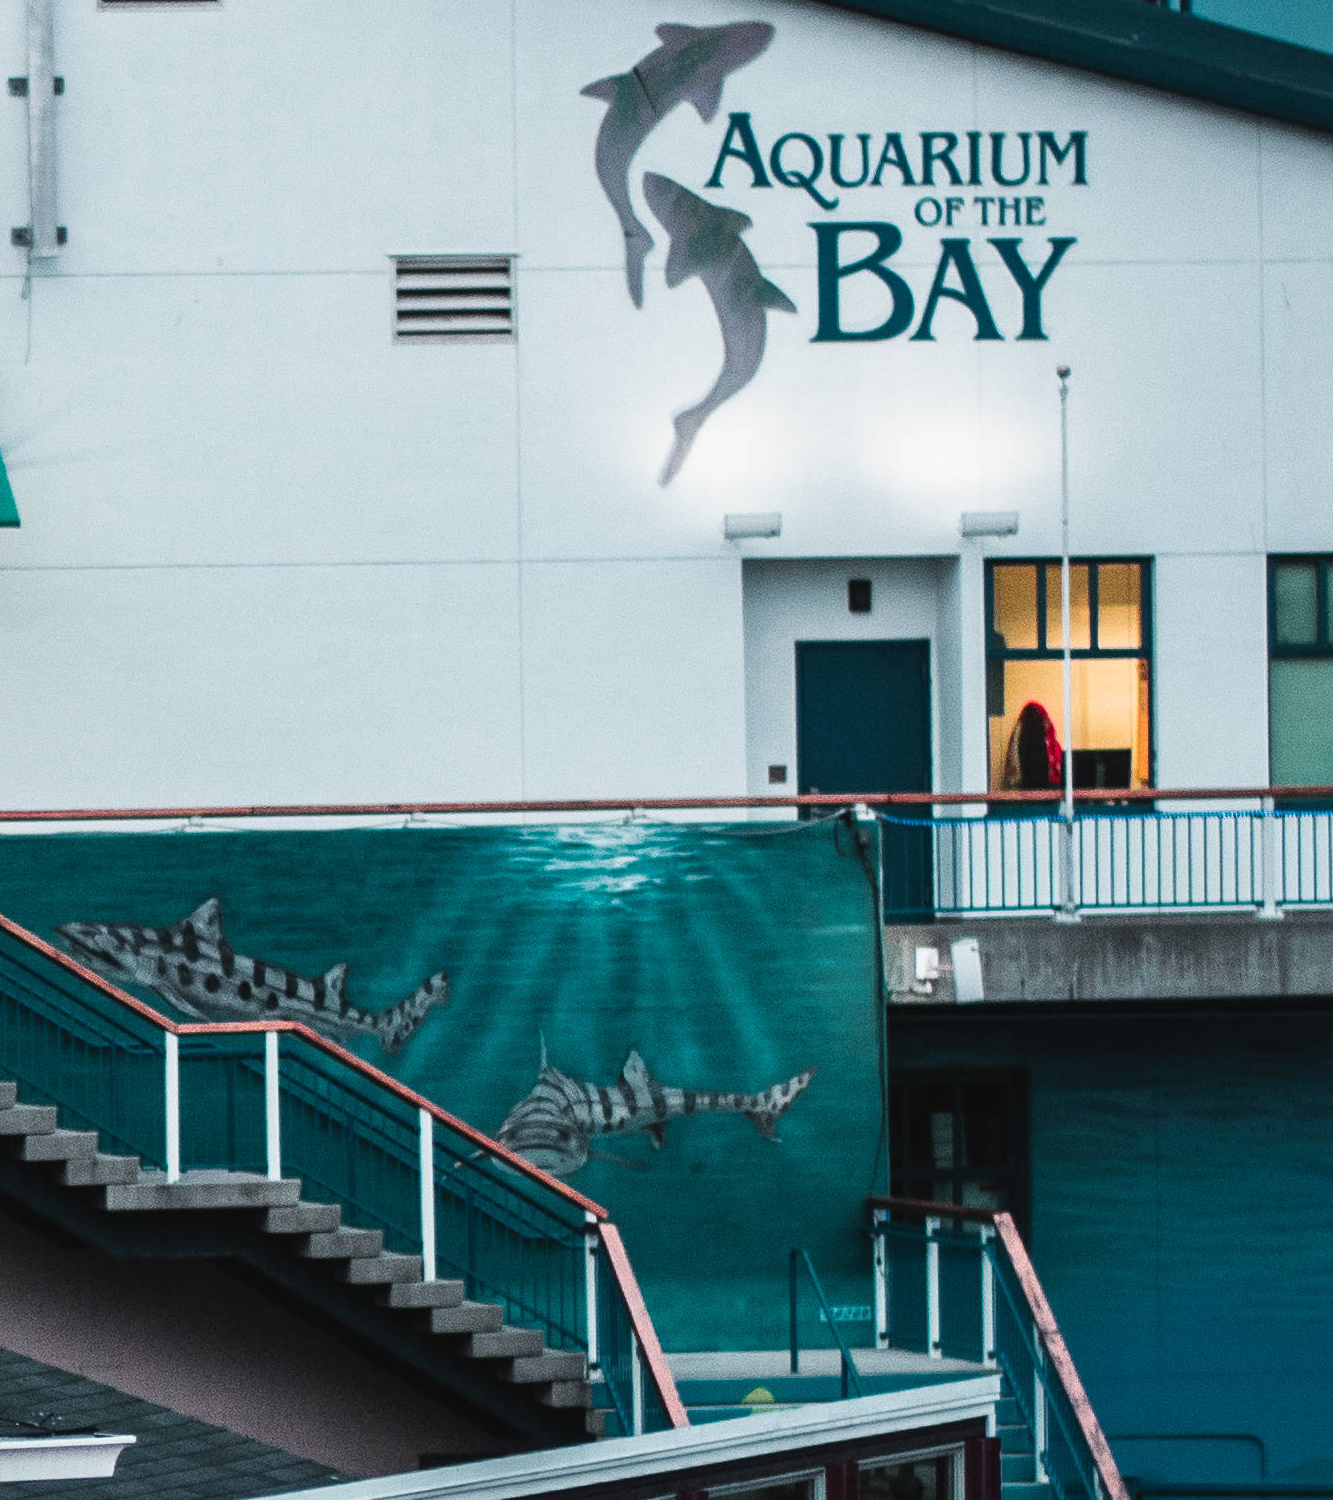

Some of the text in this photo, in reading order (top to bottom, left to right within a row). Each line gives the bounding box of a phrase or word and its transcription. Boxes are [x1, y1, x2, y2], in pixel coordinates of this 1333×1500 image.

[704, 112, 1089, 210] AQUARIUM
[914, 196, 1047, 227] OF THE
[807, 221, 1078, 343] BAY
